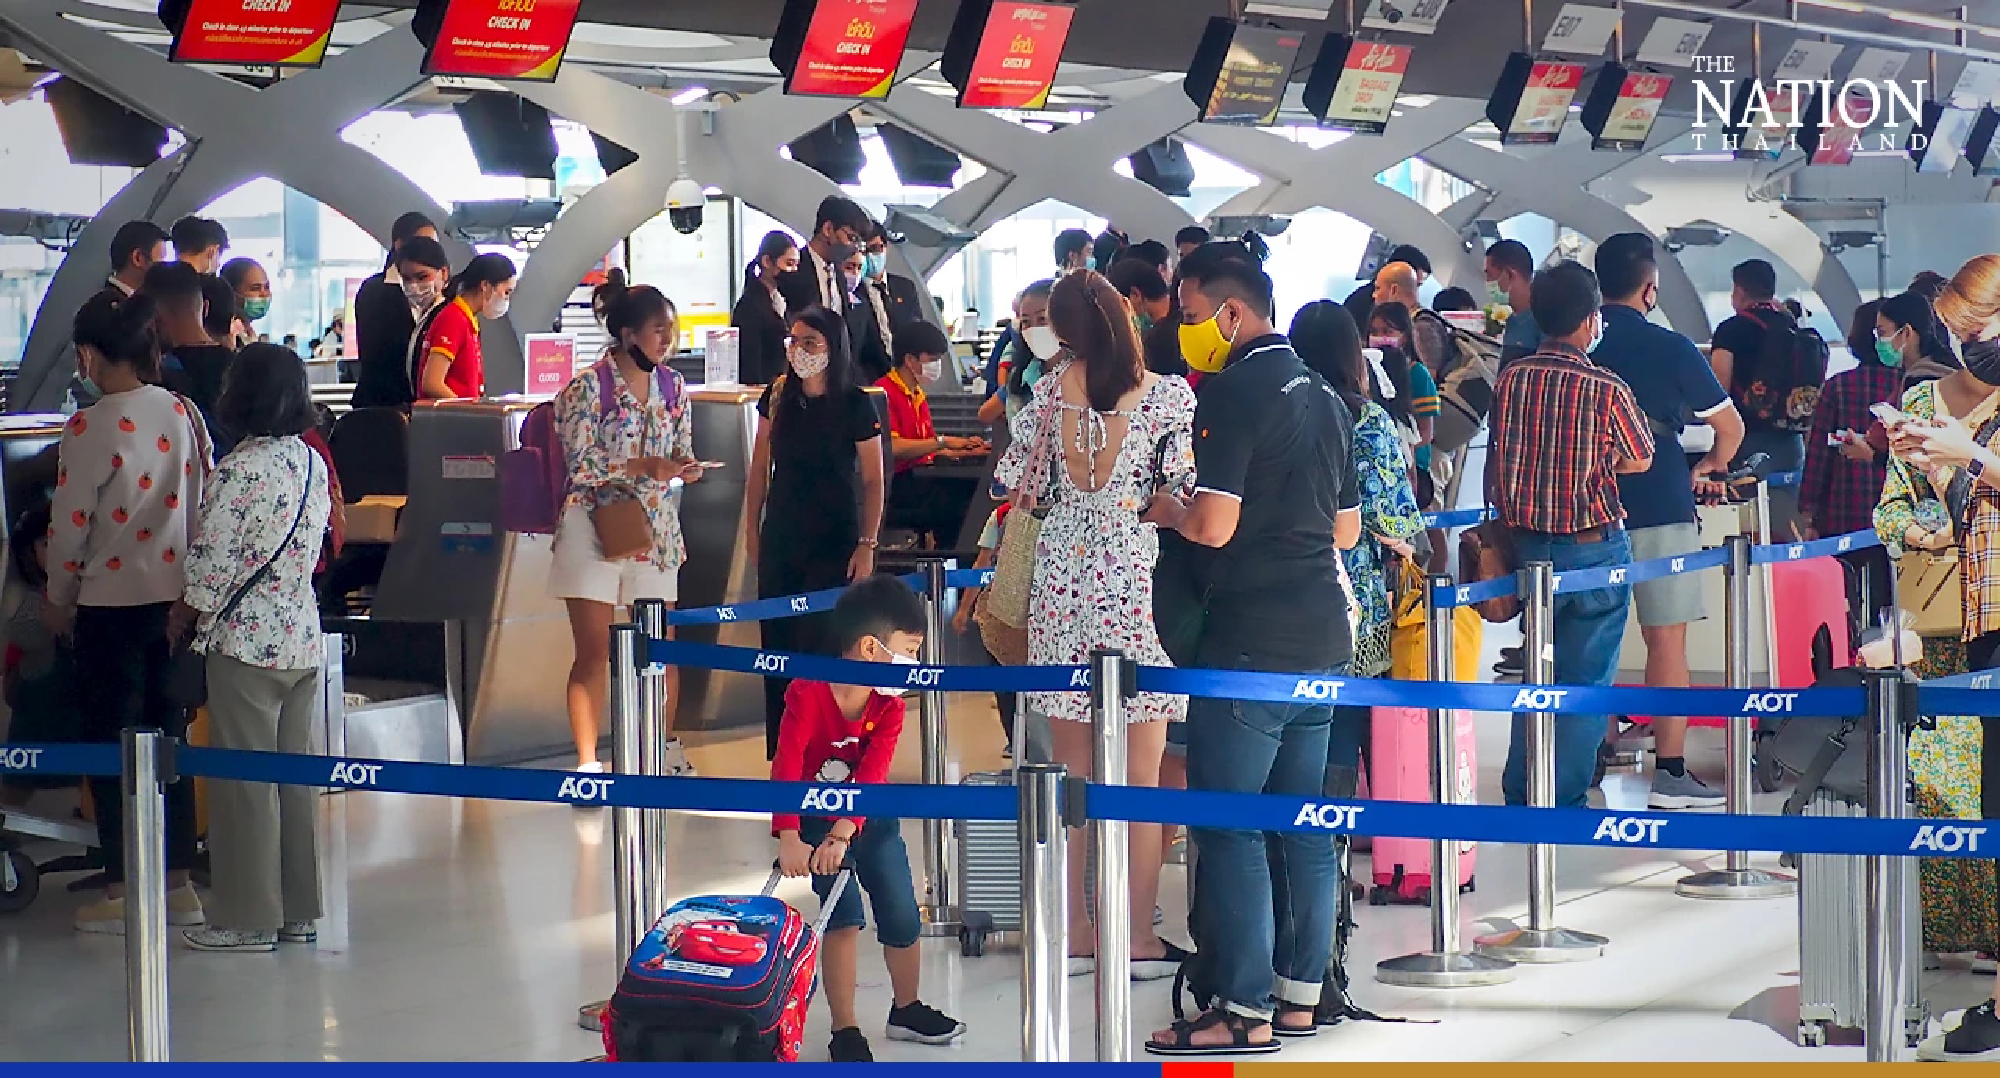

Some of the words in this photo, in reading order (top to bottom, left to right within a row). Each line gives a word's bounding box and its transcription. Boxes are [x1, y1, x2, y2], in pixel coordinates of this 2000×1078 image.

[487, 15, 520, 29] CHECK
[519, 17, 532, 31] IN
[754, 653, 790, 673] AOT
[905, 667, 945, 686] AOT
[1291, 680, 1345, 701] AOT
[1511, 688, 1568, 709] AOT
[1741, 693, 1798, 712] AOT
[330, 761, 384, 785] AOT
[558, 776, 615, 802] AOT
[800, 787, 862, 812] AOT
[1293, 802, 1365, 829] AOT
[1594, 816, 1669, 843] AOT
[1910, 825, 1987, 852] AOT
